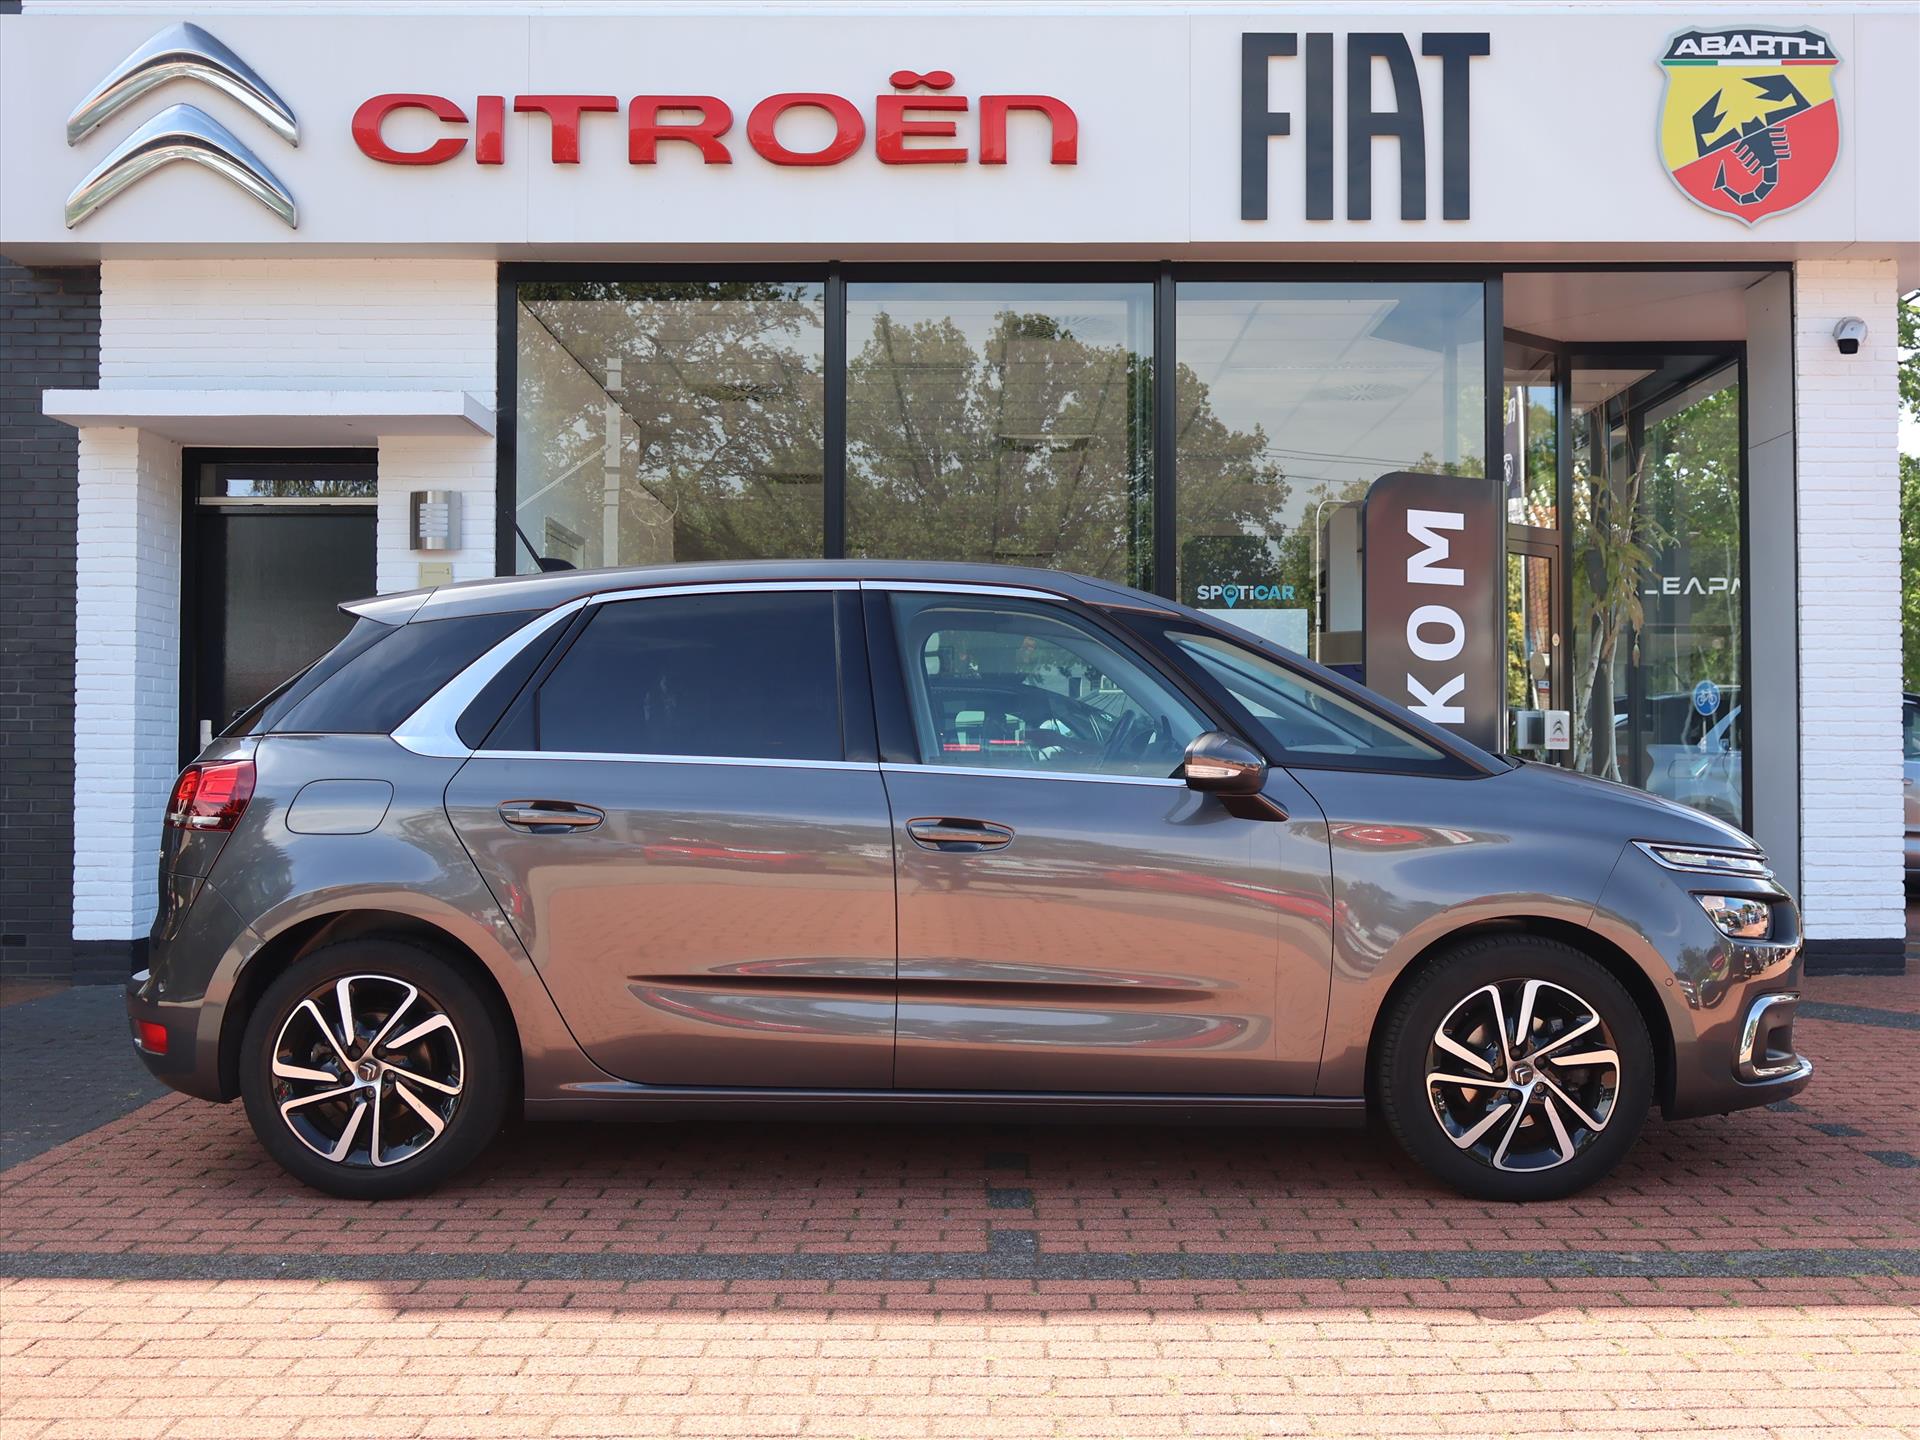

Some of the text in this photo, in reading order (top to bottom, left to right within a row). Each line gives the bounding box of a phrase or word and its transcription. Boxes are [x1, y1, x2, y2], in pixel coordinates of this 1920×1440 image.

[1673, 34, 1825, 56] ABARTH
[351, 70, 1078, 166] CITROËN
[1241, 32, 1490, 220] FIAT
